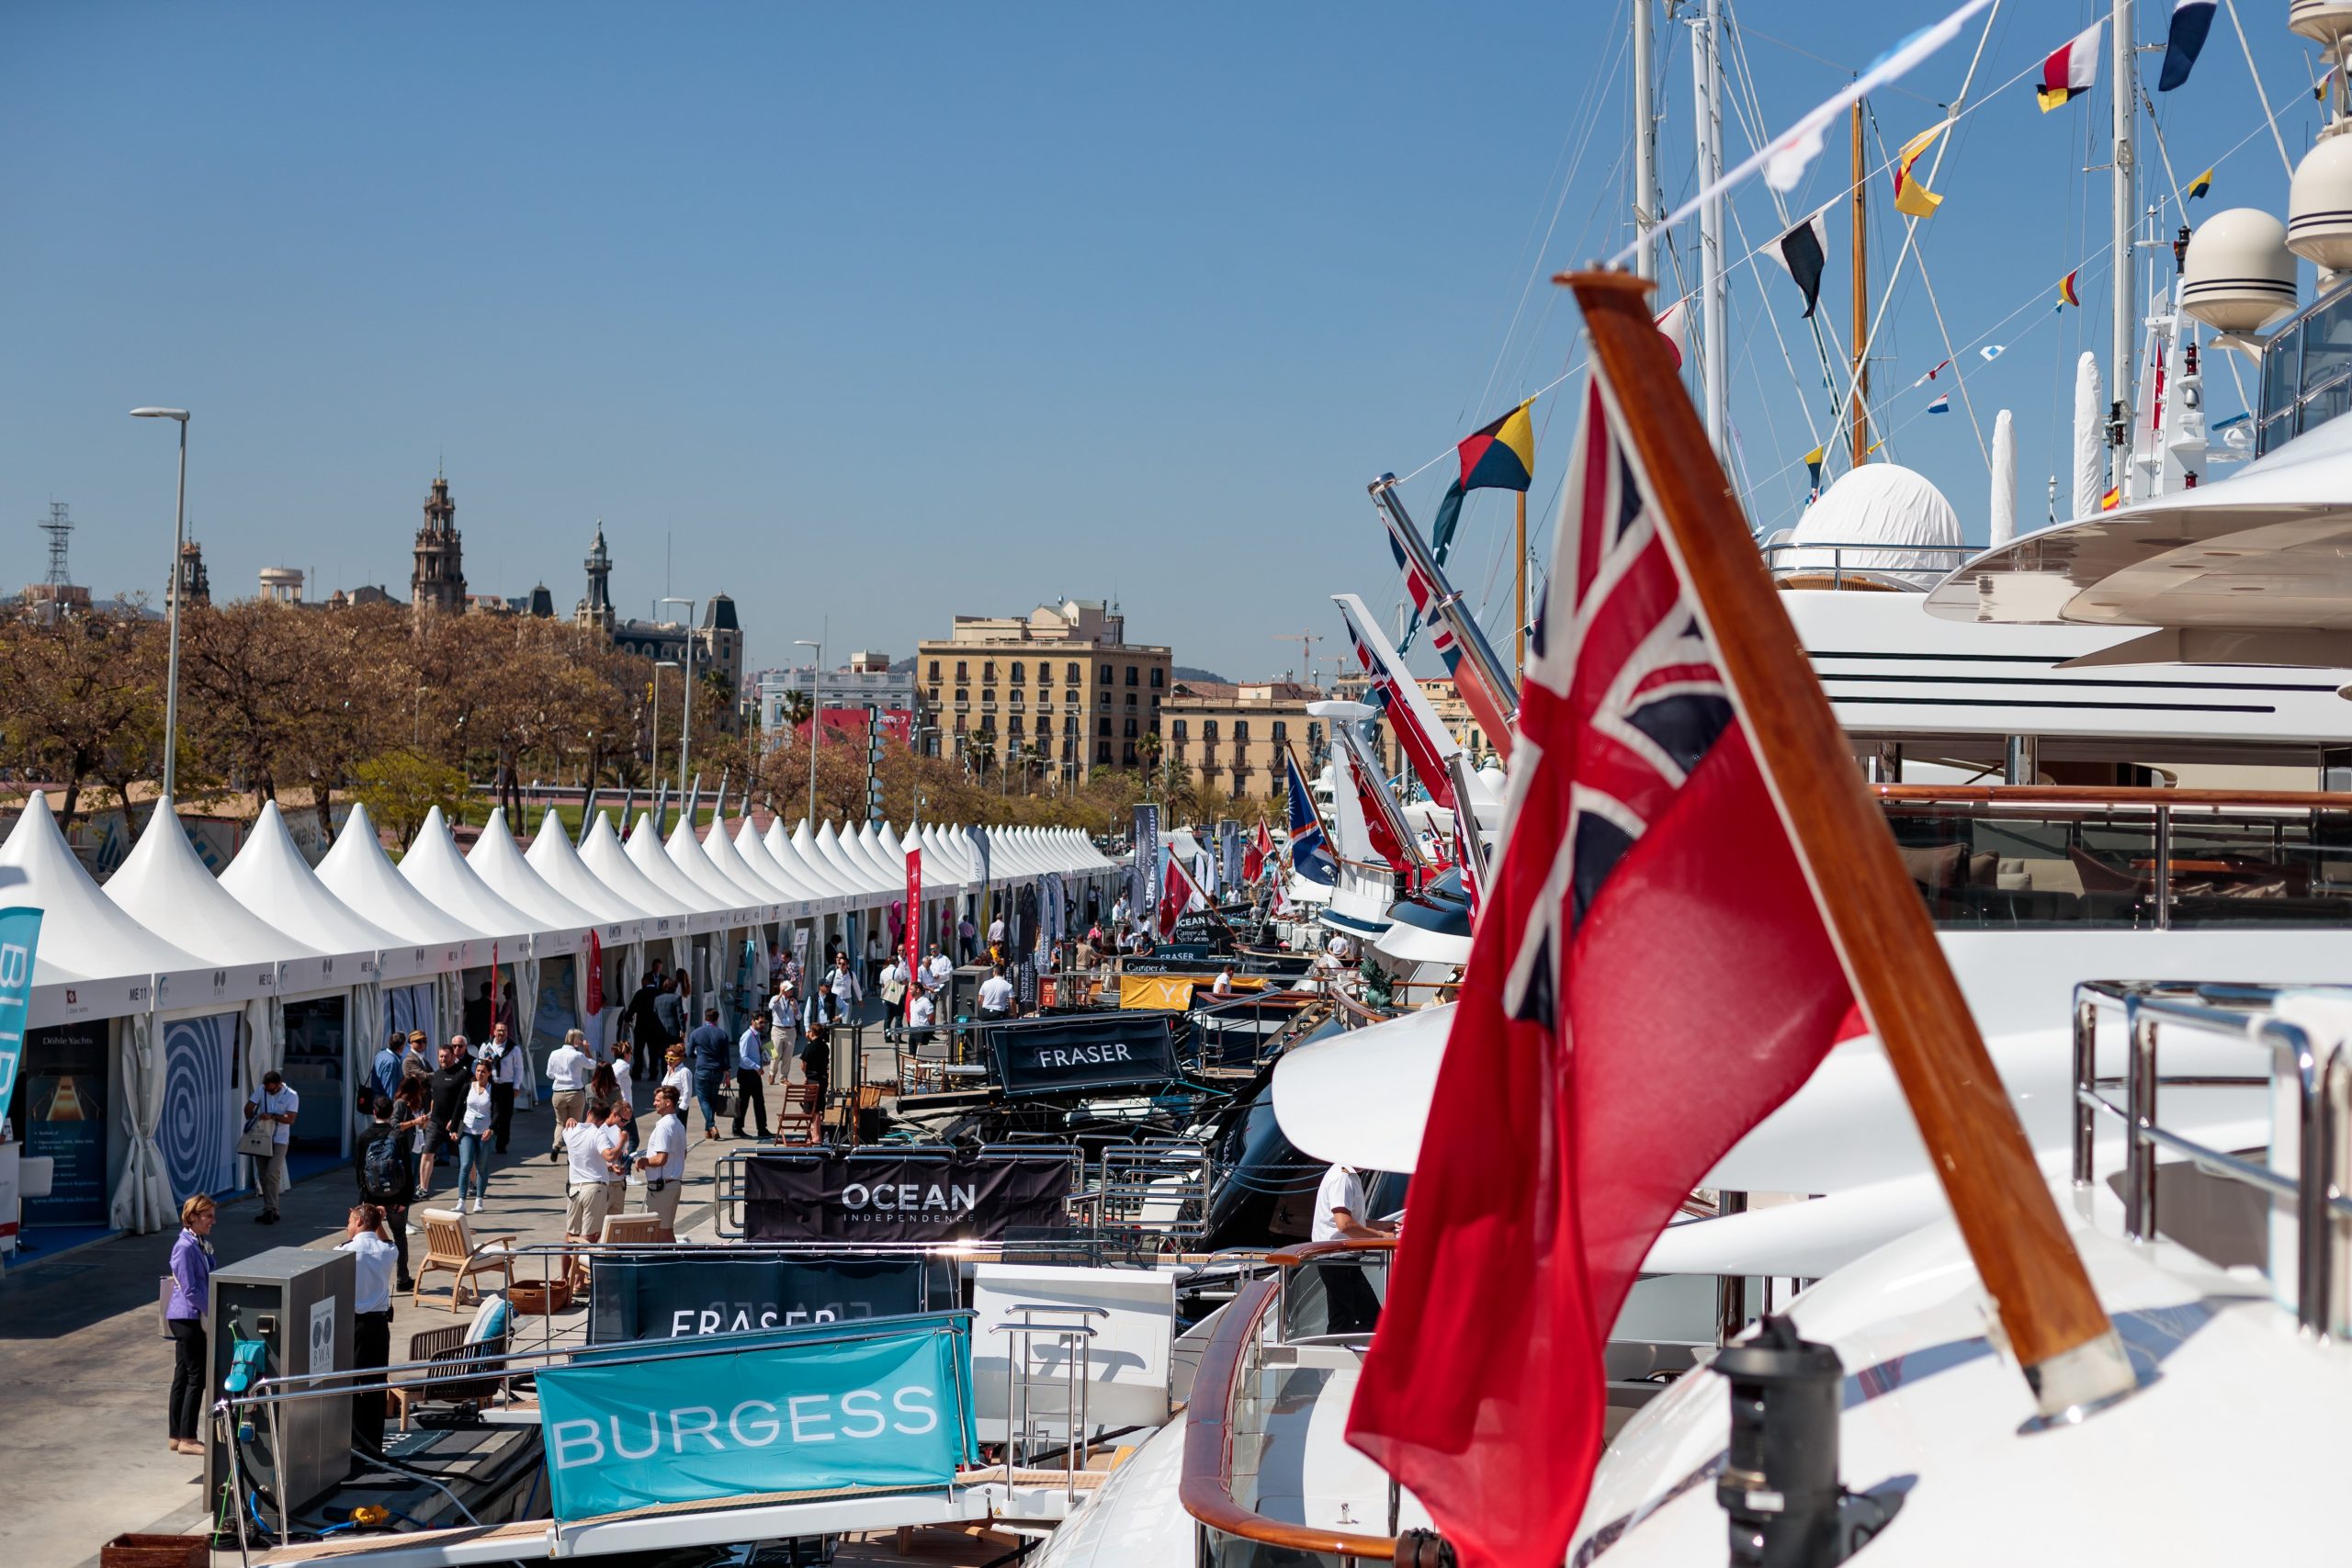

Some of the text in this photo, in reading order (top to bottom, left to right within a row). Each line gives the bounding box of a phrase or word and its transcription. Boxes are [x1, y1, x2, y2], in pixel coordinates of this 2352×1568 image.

[1177, 917, 1205, 927] CEAN
[1126, 963, 1168, 972] Camper &
[129, 987, 139, 1001] ME
[140, 987, 147, 1000] 11
[42, 1036, 93, 1045] Döhle Yachts
[1039, 1043, 1133, 1067] FRASER
[842, 1183, 976, 1211] OCEAN
[843, 1213, 974, 1223] INDEPENDENCE
[551, 1386, 938, 1470] BURGESS
